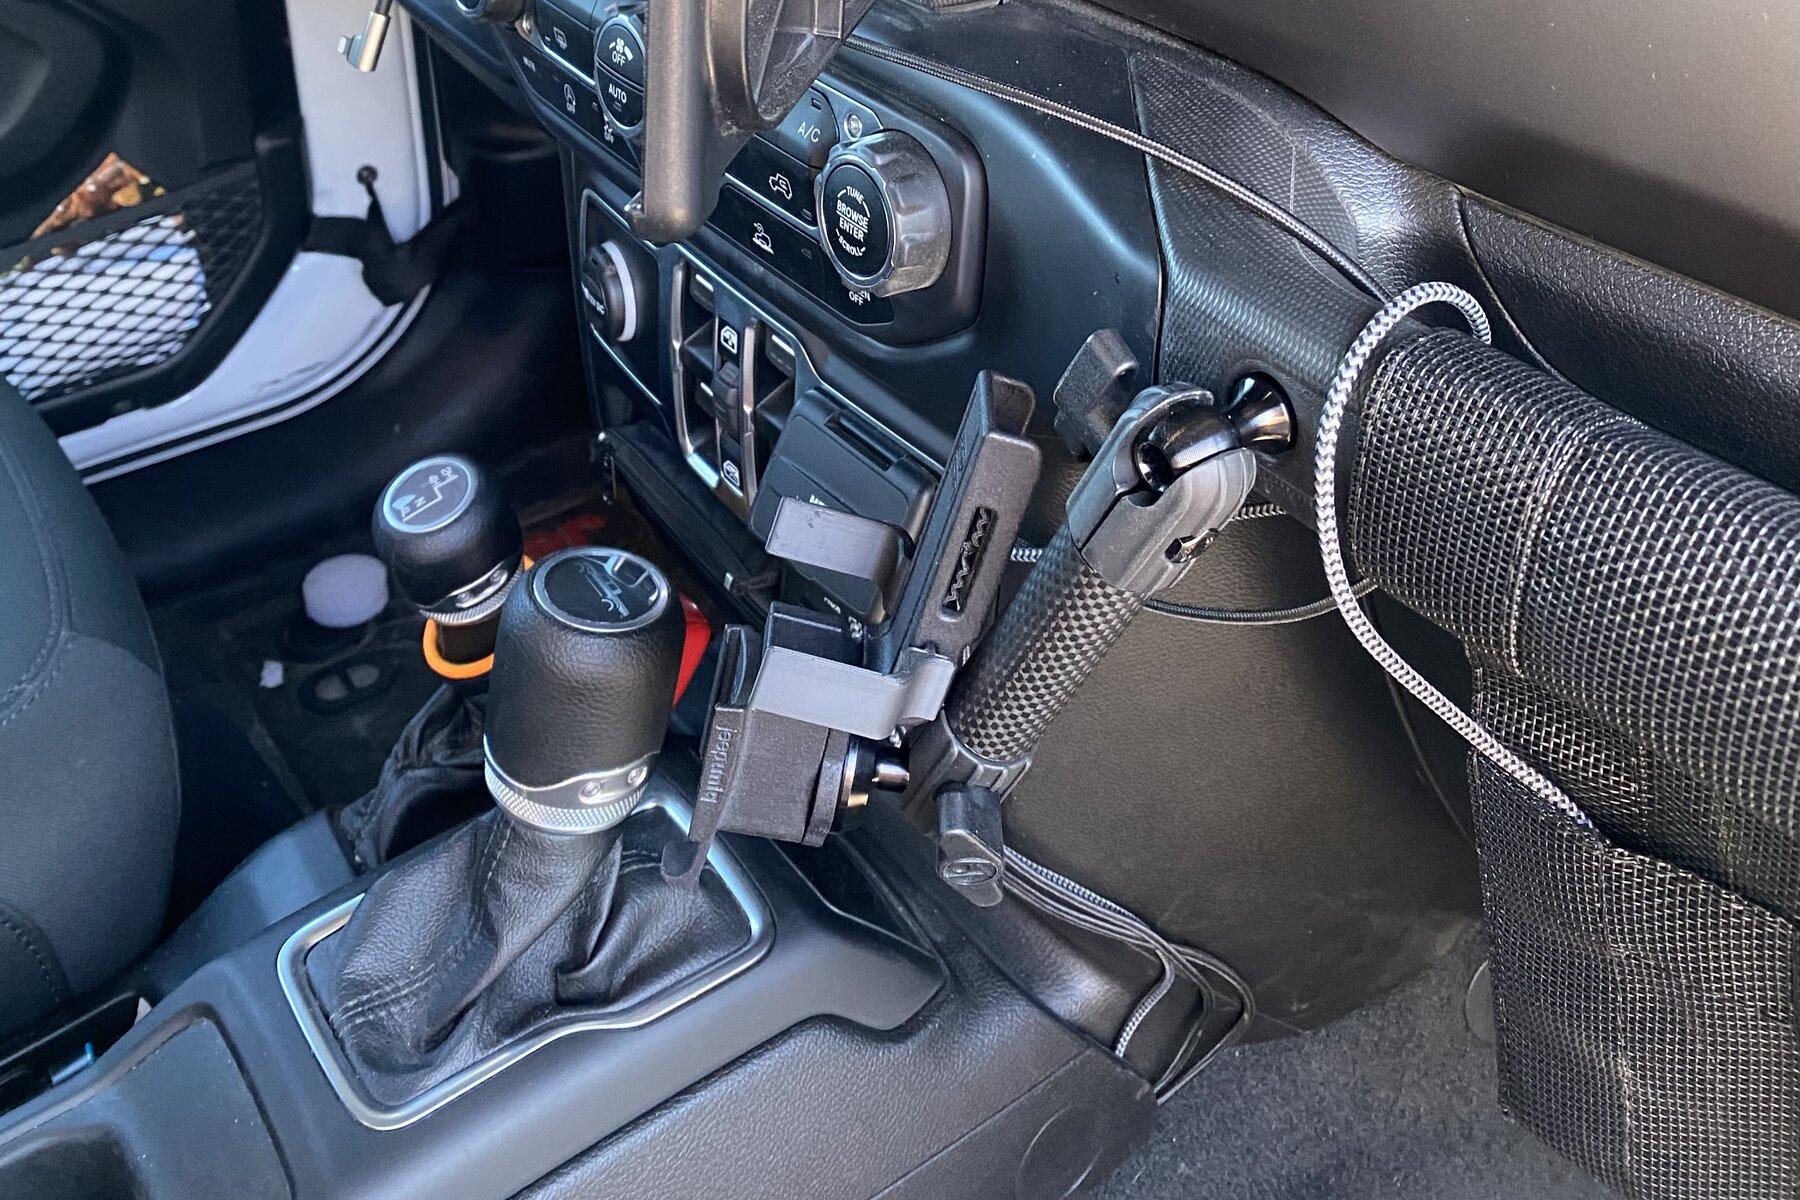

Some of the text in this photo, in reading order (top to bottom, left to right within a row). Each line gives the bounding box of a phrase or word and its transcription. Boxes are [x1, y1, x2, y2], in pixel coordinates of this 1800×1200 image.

[611, 50, 626, 67] OFF
[608, 83, 627, 104] AUTO
[797, 119, 821, 143] A/C
[846, 185, 865, 205] TUNE
[836, 199, 869, 230] BROWSE
[839, 216, 864, 242] ENTER
[838, 235, 863, 257] SCROLL
[848, 291, 864, 307] OFF
